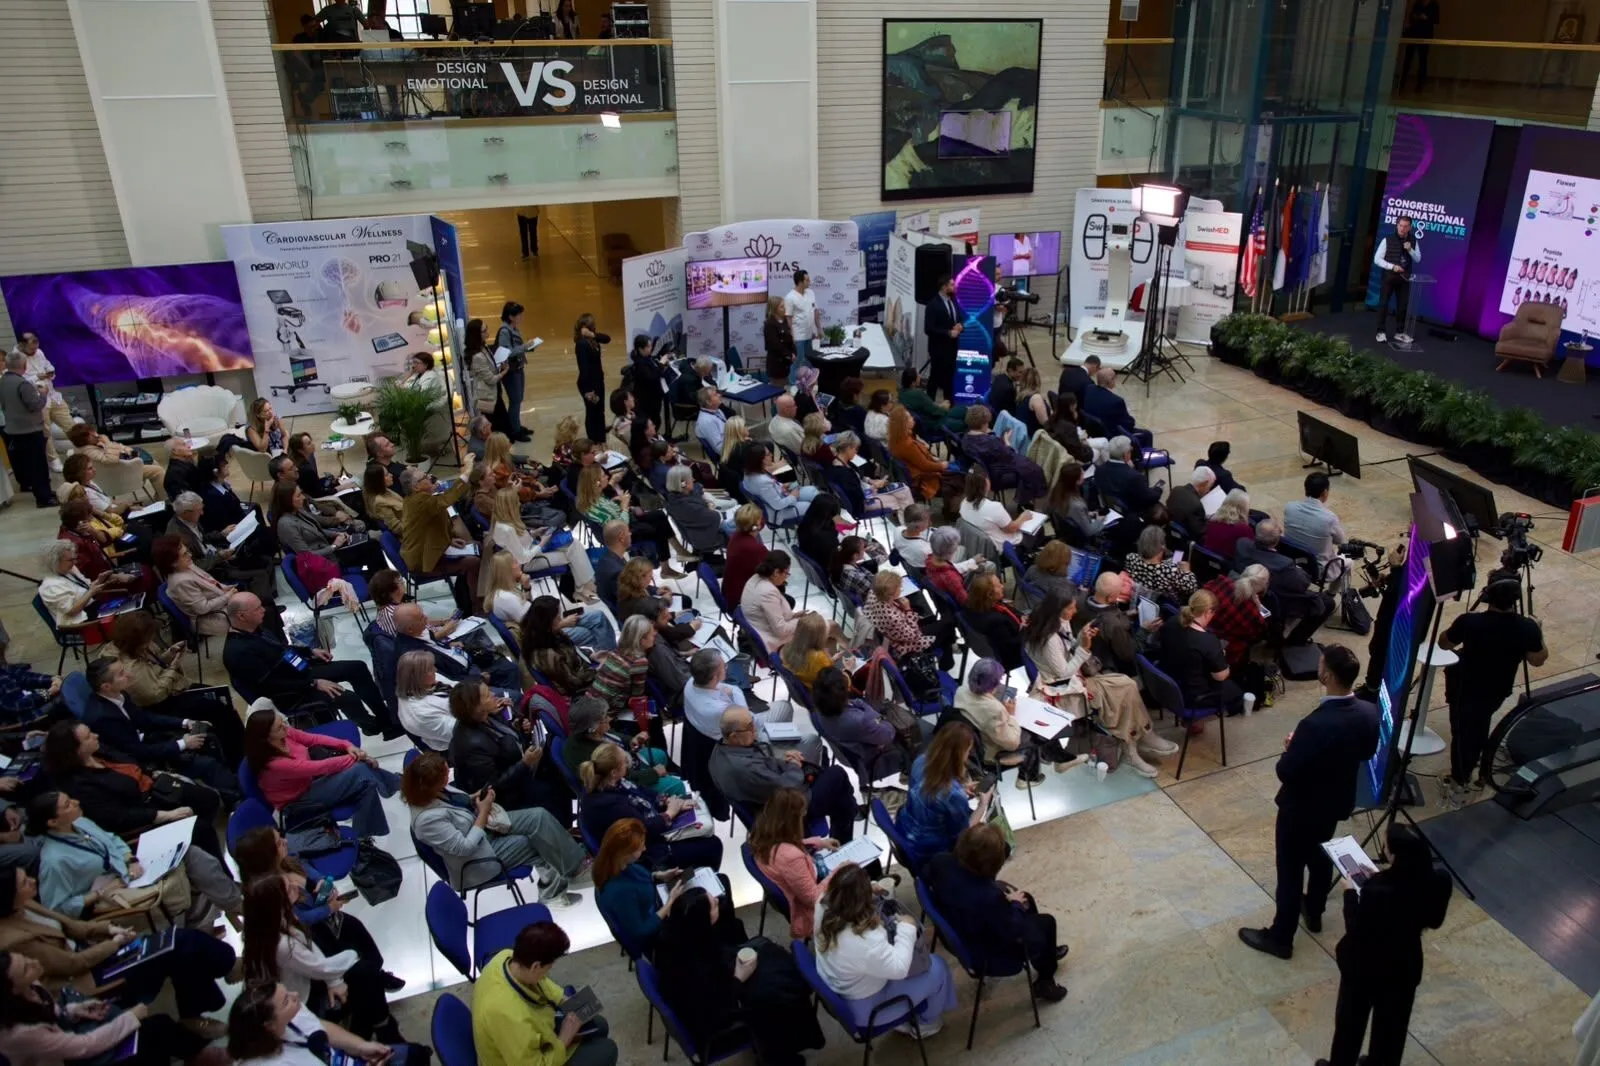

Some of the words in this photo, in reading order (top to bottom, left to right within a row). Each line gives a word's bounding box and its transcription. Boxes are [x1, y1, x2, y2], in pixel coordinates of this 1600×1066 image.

[437, 62, 487, 74] DESIGN
[407, 78, 488, 90] EMOTIONAL
[500, 60, 576, 107] VS
[583, 79, 629, 91] DESIGN
[584, 94, 645, 105] RATIONAL
[1387, 197, 1446, 214] CONGRESUL
[1384, 215, 1398, 225] DE
[1386, 206, 1466, 227] INTERNATIONAL
[262, 230, 347, 245] CARDIOVASCULAR
[351, 223, 403, 239] WELLNESS
[369, 254, 391, 264] PRO
[392, 254, 401, 262] 21
[638, 273, 674, 289] VITALITAS
